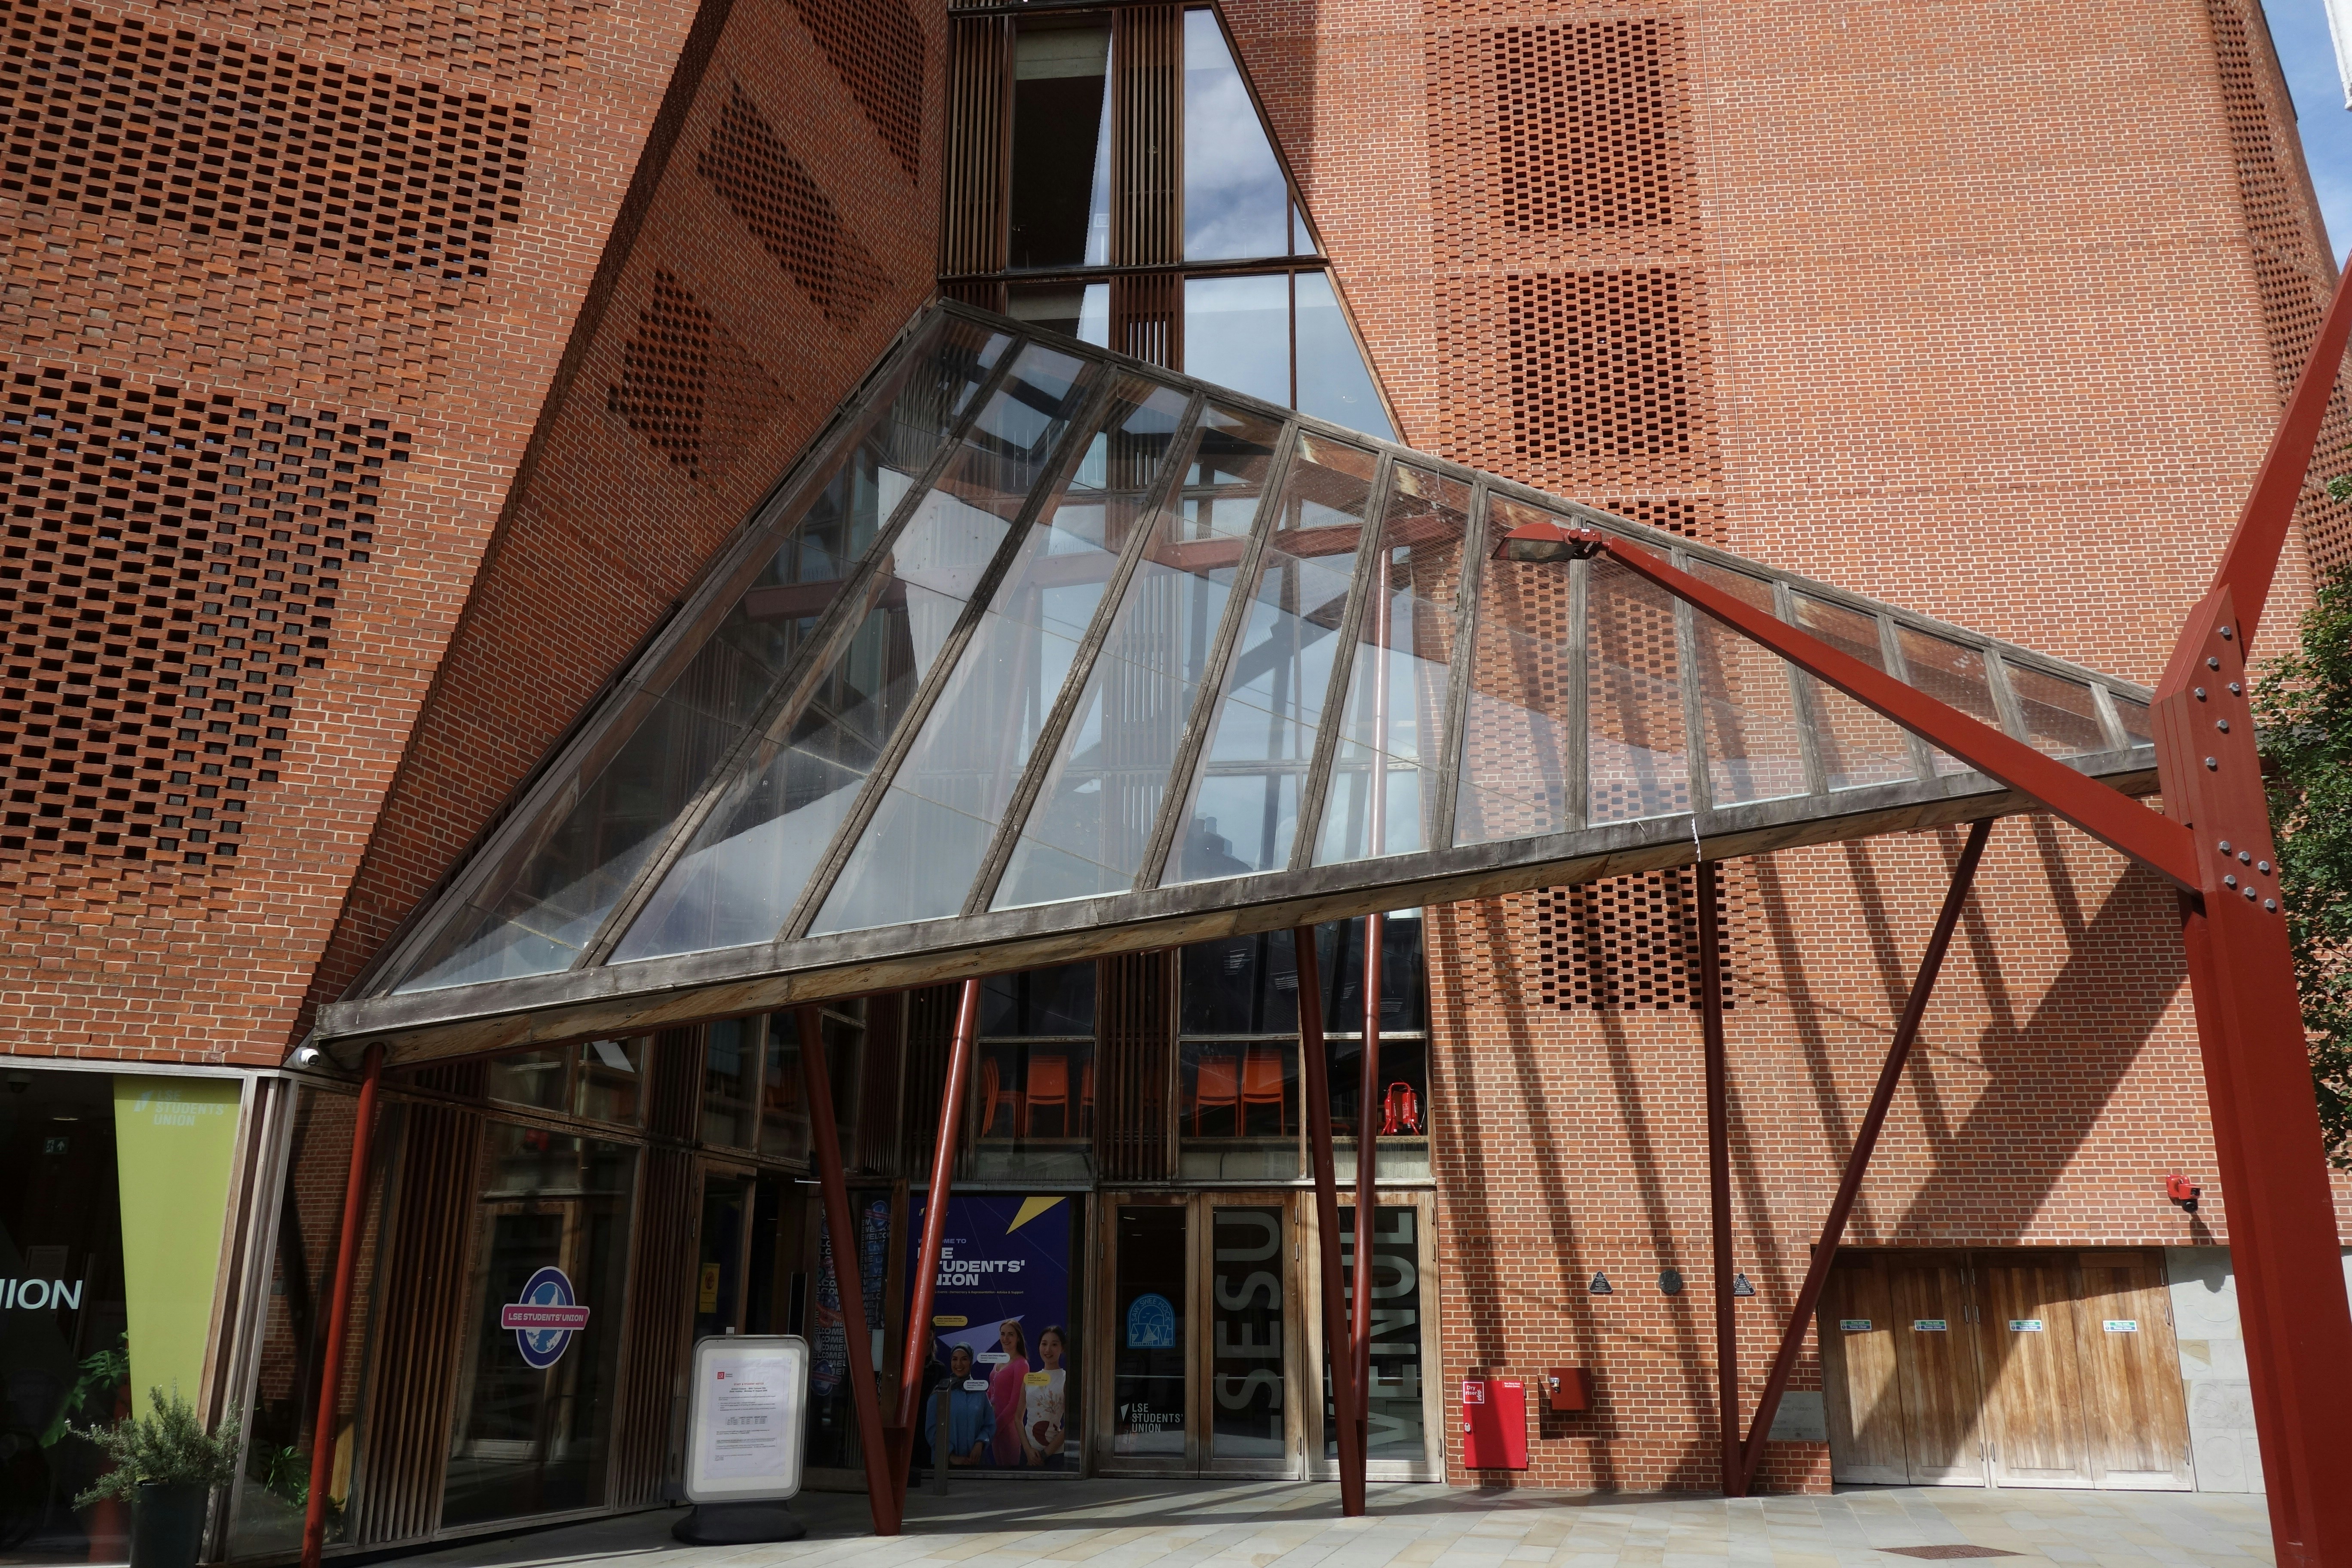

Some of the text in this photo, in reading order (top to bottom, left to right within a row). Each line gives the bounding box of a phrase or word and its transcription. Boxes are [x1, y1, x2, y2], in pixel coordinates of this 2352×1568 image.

[157, 1090, 182, 1101] LSE
[154, 1114, 196, 1126] UNION
[939, 1260, 1025, 1272] UDENTS'
[1131, 1298, 1171, 1322] SAW SWEE HOCK
[1132, 1403, 1148, 1412] LSE
[1132, 1423, 1161, 1433] UNION
